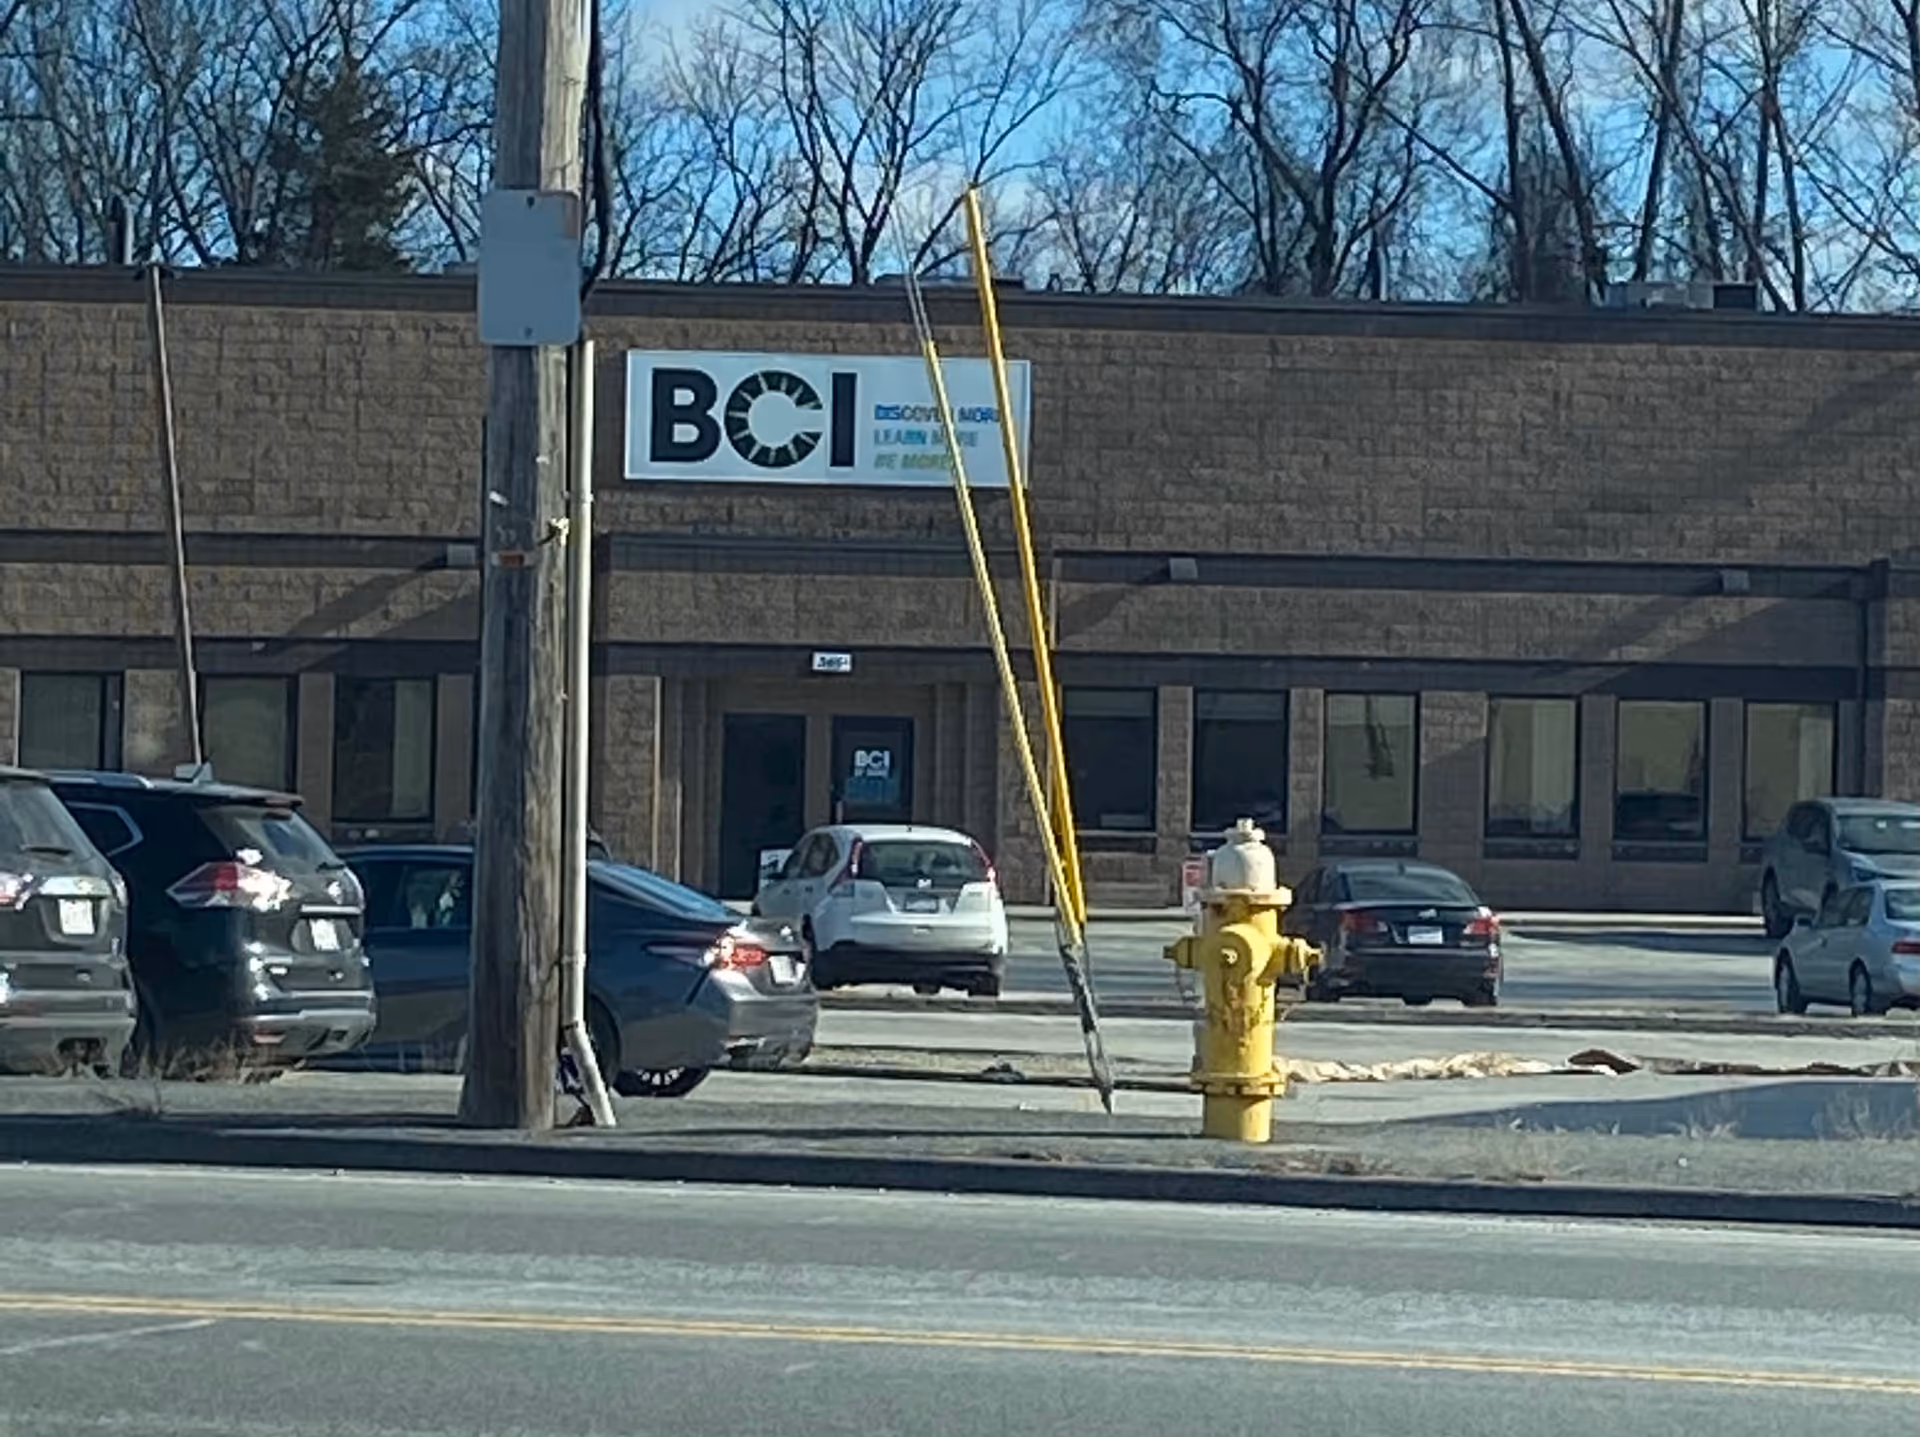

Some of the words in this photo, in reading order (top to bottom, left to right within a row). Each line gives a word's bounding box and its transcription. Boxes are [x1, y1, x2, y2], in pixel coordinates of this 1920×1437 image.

[650, 367, 858, 469] BCI
[874, 429, 926, 446] LEARN
[854, 750, 890, 769] BCI
